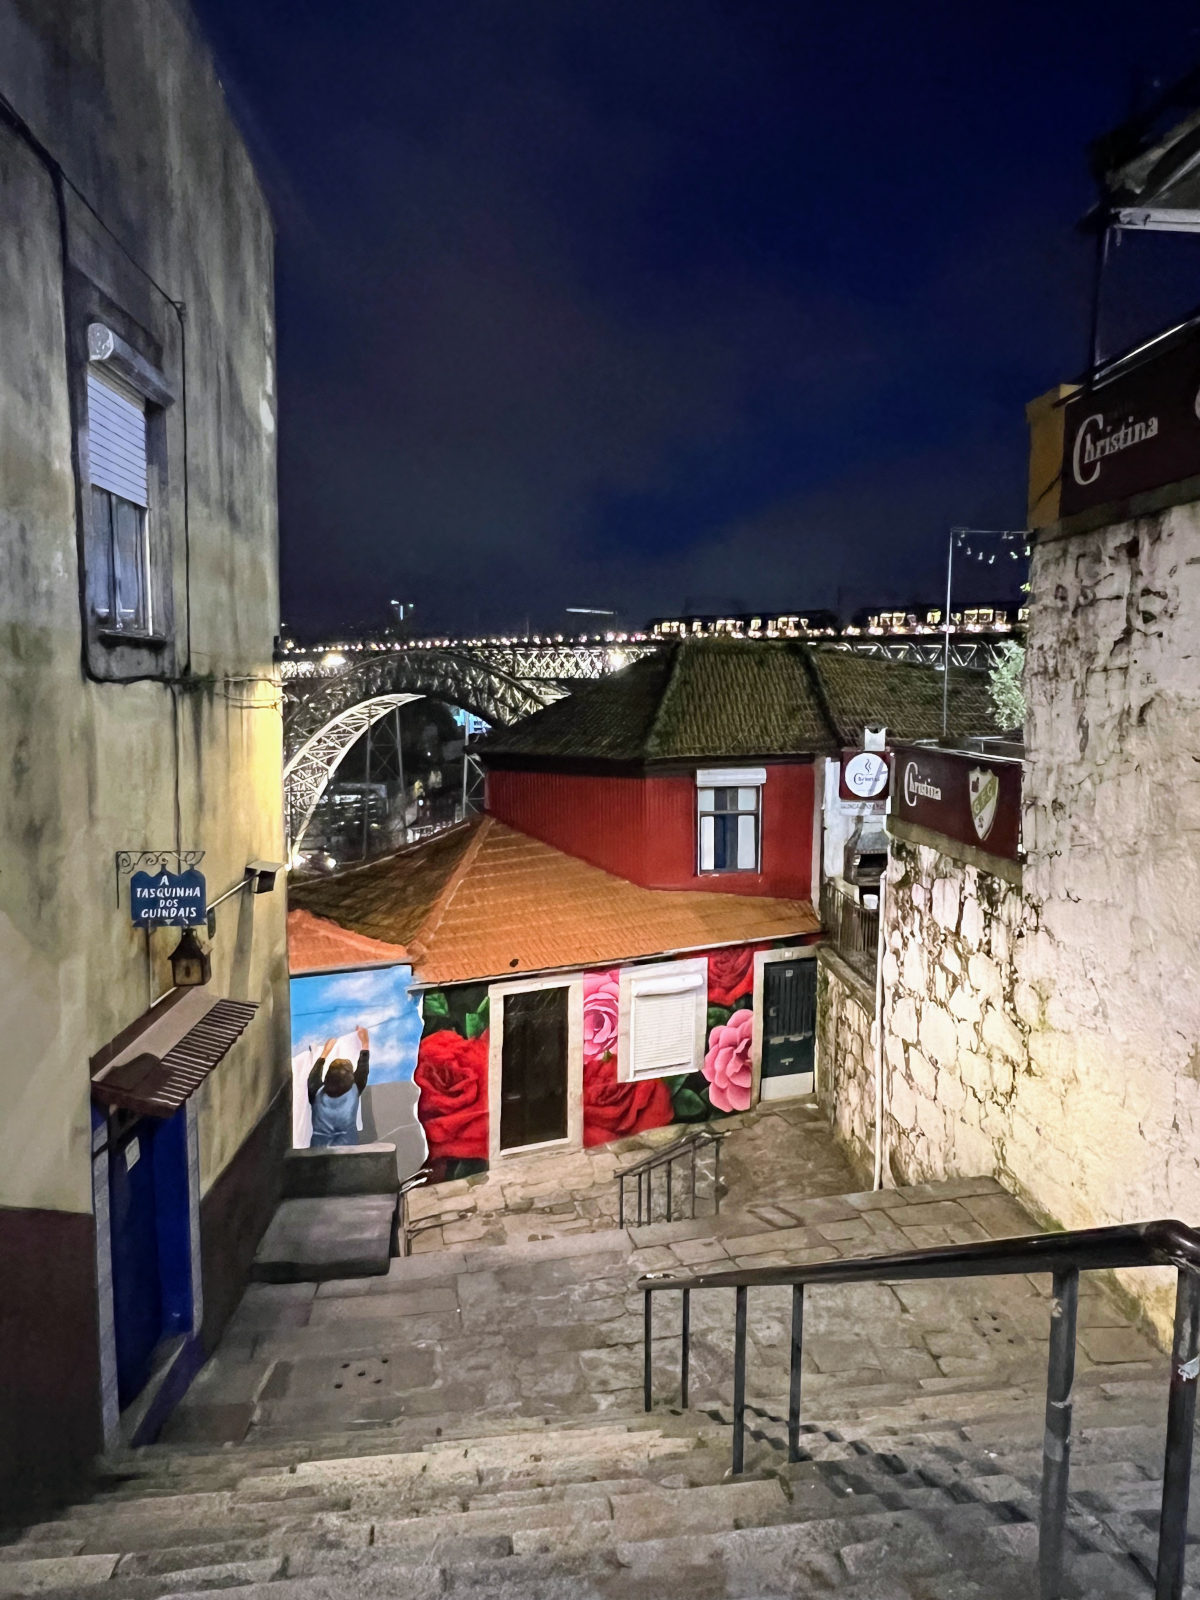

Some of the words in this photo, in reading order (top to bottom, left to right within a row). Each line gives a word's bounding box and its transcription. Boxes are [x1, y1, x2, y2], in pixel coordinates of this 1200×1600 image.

[1072, 413, 1159, 486] Christina
[903, 761, 942, 807] Christina
[159, 875, 169, 886] A
[136, 886, 201, 899] TASQUINHA
[159, 899, 179, 908] DOS
[141, 907, 197, 918] GUINDAIS
